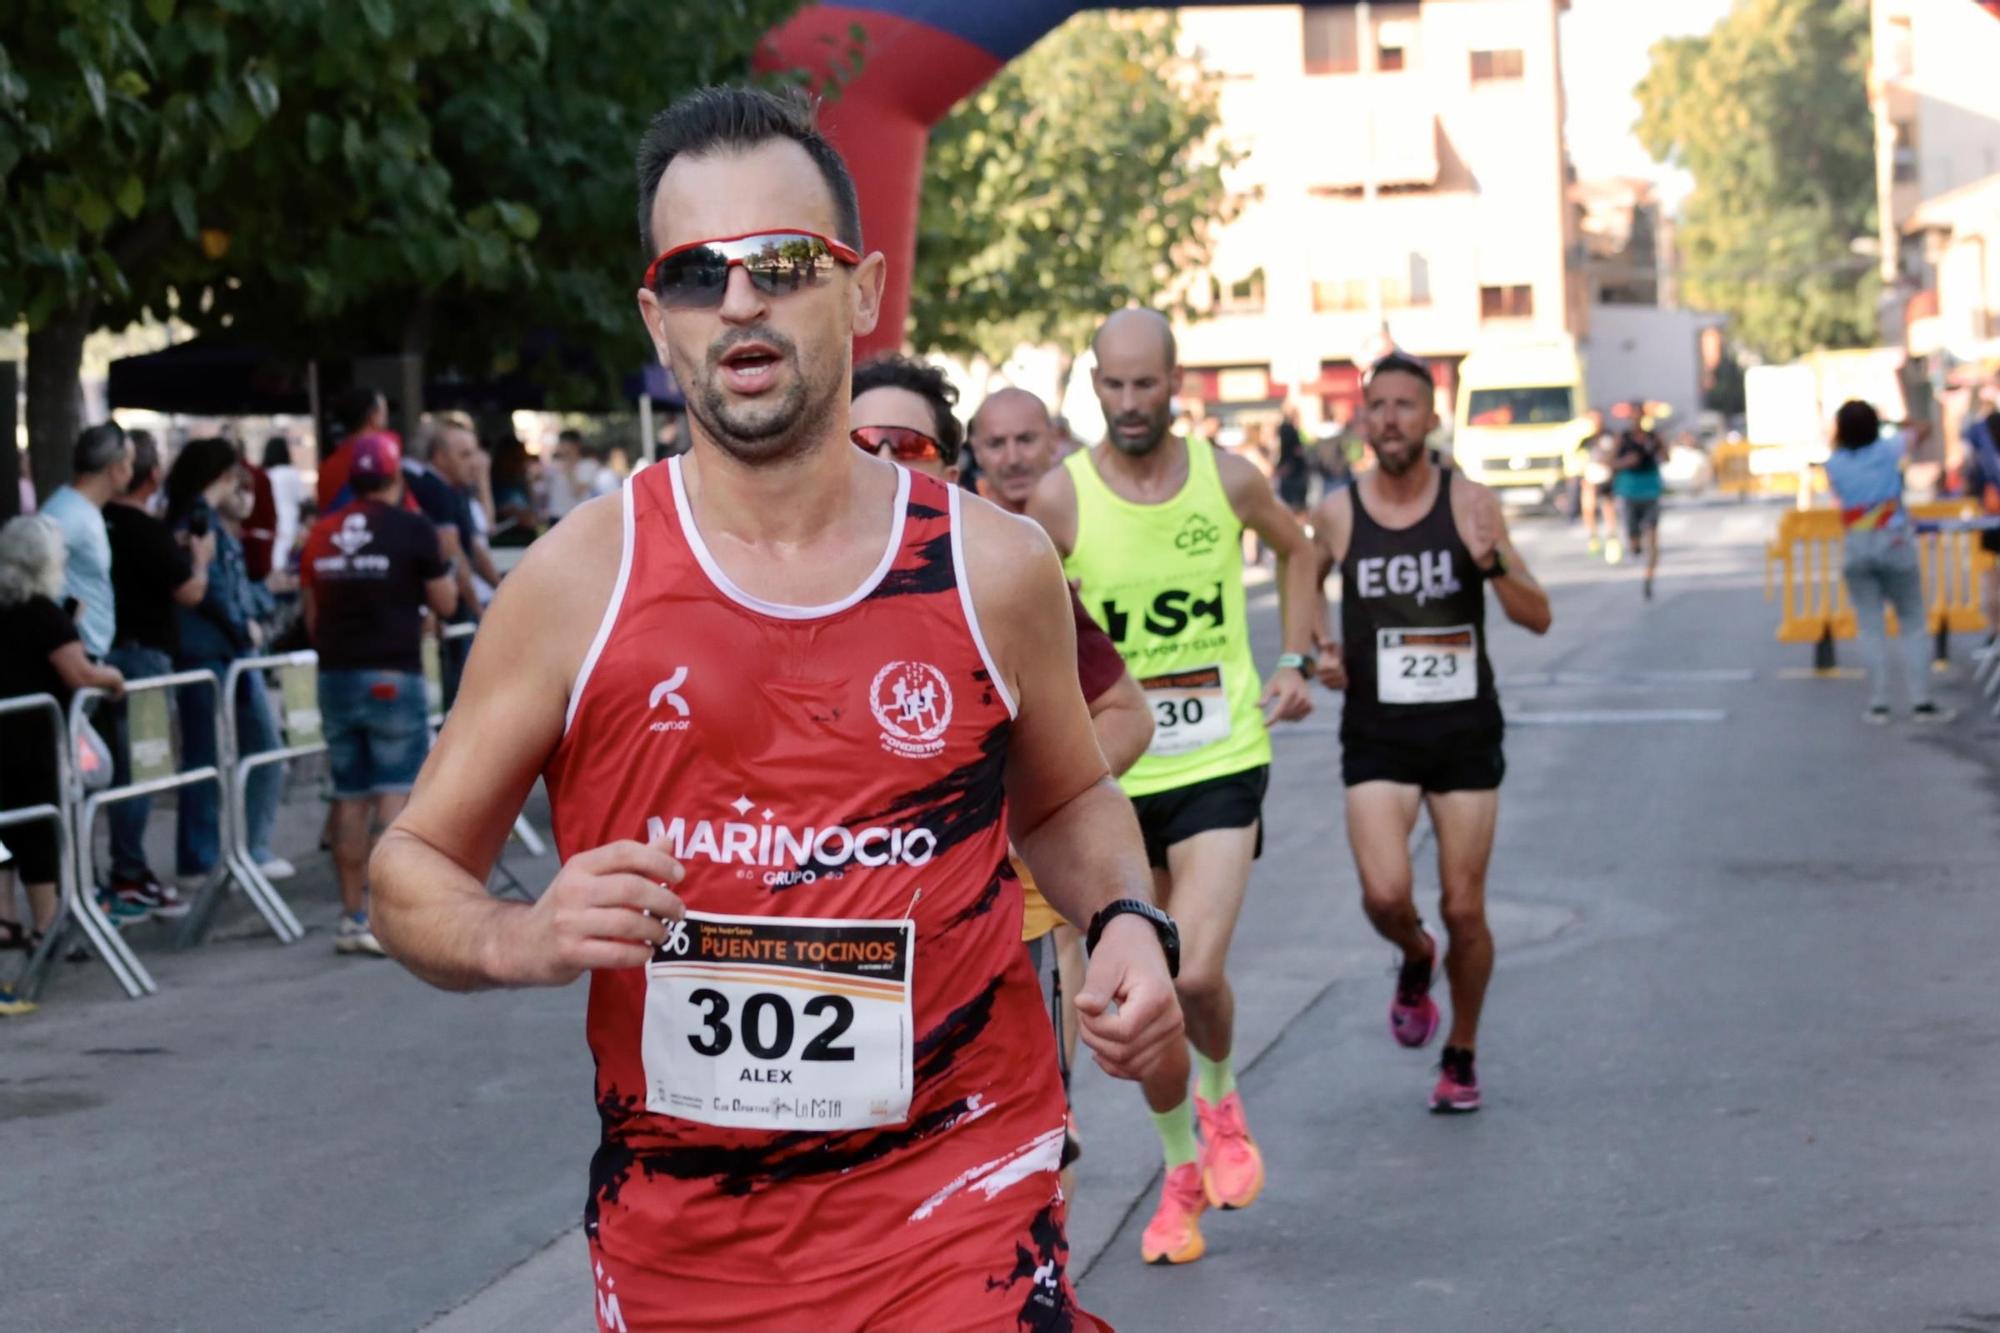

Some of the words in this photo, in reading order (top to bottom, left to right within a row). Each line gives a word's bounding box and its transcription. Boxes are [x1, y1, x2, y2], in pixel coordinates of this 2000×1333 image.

[1357, 549, 1453, 598] EGH
[1401, 653, 1457, 678] 223
[880, 732, 946, 753] FONDISTAS
[647, 815, 938, 867] MARINOCIO
[762, 869, 817, 886] GRUPO
[702, 936, 787, 960] PUENTE
[793, 941, 897, 962] TOCINOS
[687, 988, 855, 1061] 302
[739, 1067, 793, 1084] ALEX
